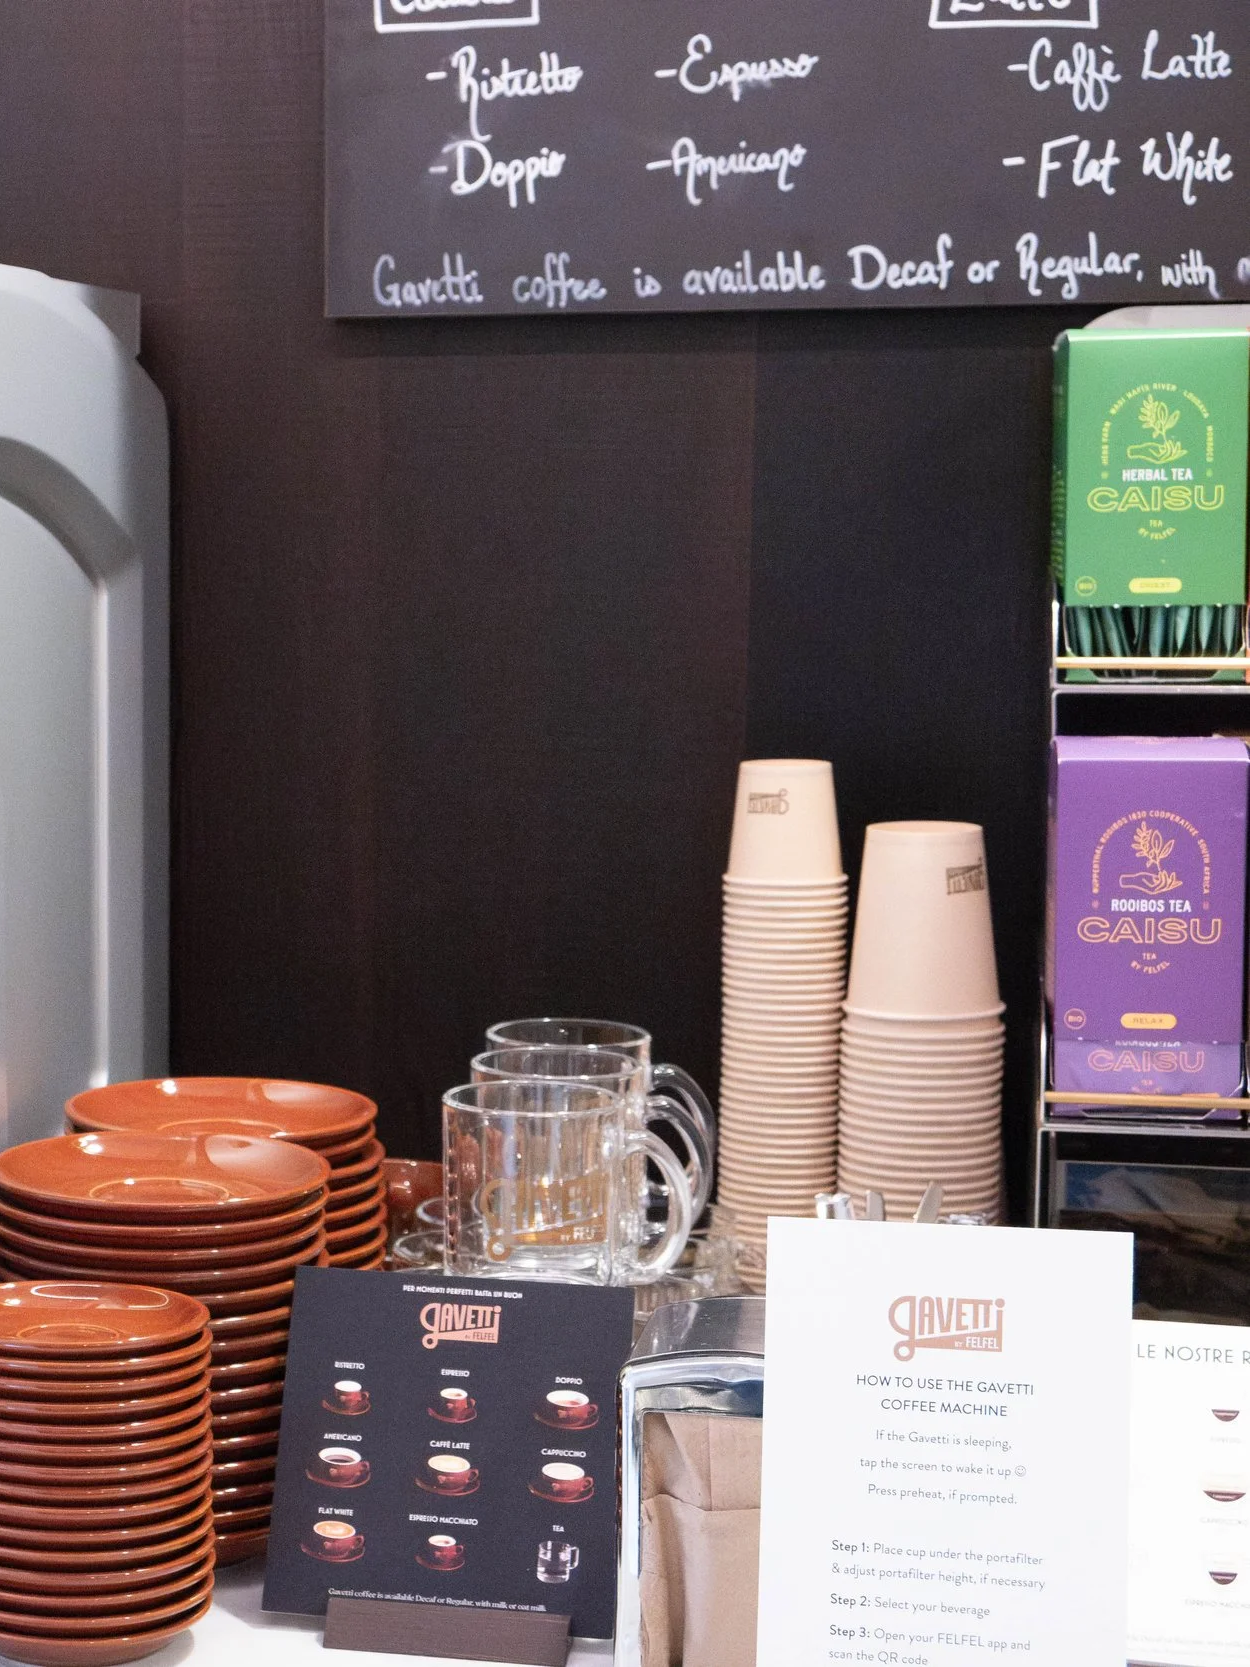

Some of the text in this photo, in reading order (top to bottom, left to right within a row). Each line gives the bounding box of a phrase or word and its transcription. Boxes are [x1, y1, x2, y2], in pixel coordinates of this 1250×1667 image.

[1141, 29, 1232, 80] Latte
[1037, 130, 1234, 206] Flat White
[373, 253, 483, 307] Gavetti
[512, 251, 607, 308] coffee
[633, 267, 662, 298] is
[682, 249, 826, 296] available
[847, 232, 954, 290] Decaf
[966, 259, 1000, 284] or
[1015, 231, 1144, 300] Regular,
[1160, 248, 1220, 300] with
[1122, 467, 1193, 482] HERBAL TEA
[1087, 484, 1225, 513] CAISU
[1149, 810, 1199, 836] COOPERATIVE
[1111, 899, 1192, 913] ROOIBOS TEA
[1077, 916, 1222, 945] CAISU
[1067, 1015, 1083, 1024] BIO
[1132, 1017, 1164, 1025] RELAX
[1087, 1049, 1205, 1073] CAISU
[402, 1284, 415, 1292] PER
[446, 1287, 473, 1296] PERFETTI
[472, 1332, 495, 1341] FELFEL
[954, 1336, 1000, 1349] BY FELFEL
[1136, 1343, 1156, 1359] LE
[1165, 1346, 1233, 1364] NOSTRE
[334, 1360, 365, 1370] RISTRETTO
[441, 1369, 470, 1378] ESPRESSO
[555, 1376, 583, 1385] DOPPIO
[856, 1374, 1034, 1395] HOW TO USE THE GAVETTI
[881, 1398, 1008, 1417] COFFEE MACHINE
[323, 1433, 362, 1442] AMERICANO
[452, 1441, 470, 1450] LATTE
[876, 1429, 1012, 1452] If the Gavetti is sleeping,
[541, 1448, 586, 1458] CAPPUCCINO
[860, 1458, 1011, 1480] tap the screen to wake it up
[868, 1484, 1018, 1506] Press preheat, if prompted.
[318, 1507, 354, 1516] FLAT WHITE
[409, 1514, 478, 1526] ESPRESSO MACCHIATO
[552, 1524, 564, 1533] TEA
[831, 1540, 1043, 1566] Step 1: Place cup under the portafilter
[831, 1562, 1045, 1592] & adjust portafilter height, if necessary
[354, 1590, 376, 1599] coffee
[377, 1591, 384, 1599] is
[415, 1594, 437, 1603] Decaf
[475, 1600, 491, 1608] with
[830, 1593, 990, 1619] Step 2: Select your beverage
[829, 1624, 1031, 1652] Step 3: Open your FELFEL app and
[829, 1649, 928, 1666] scan the QR code
